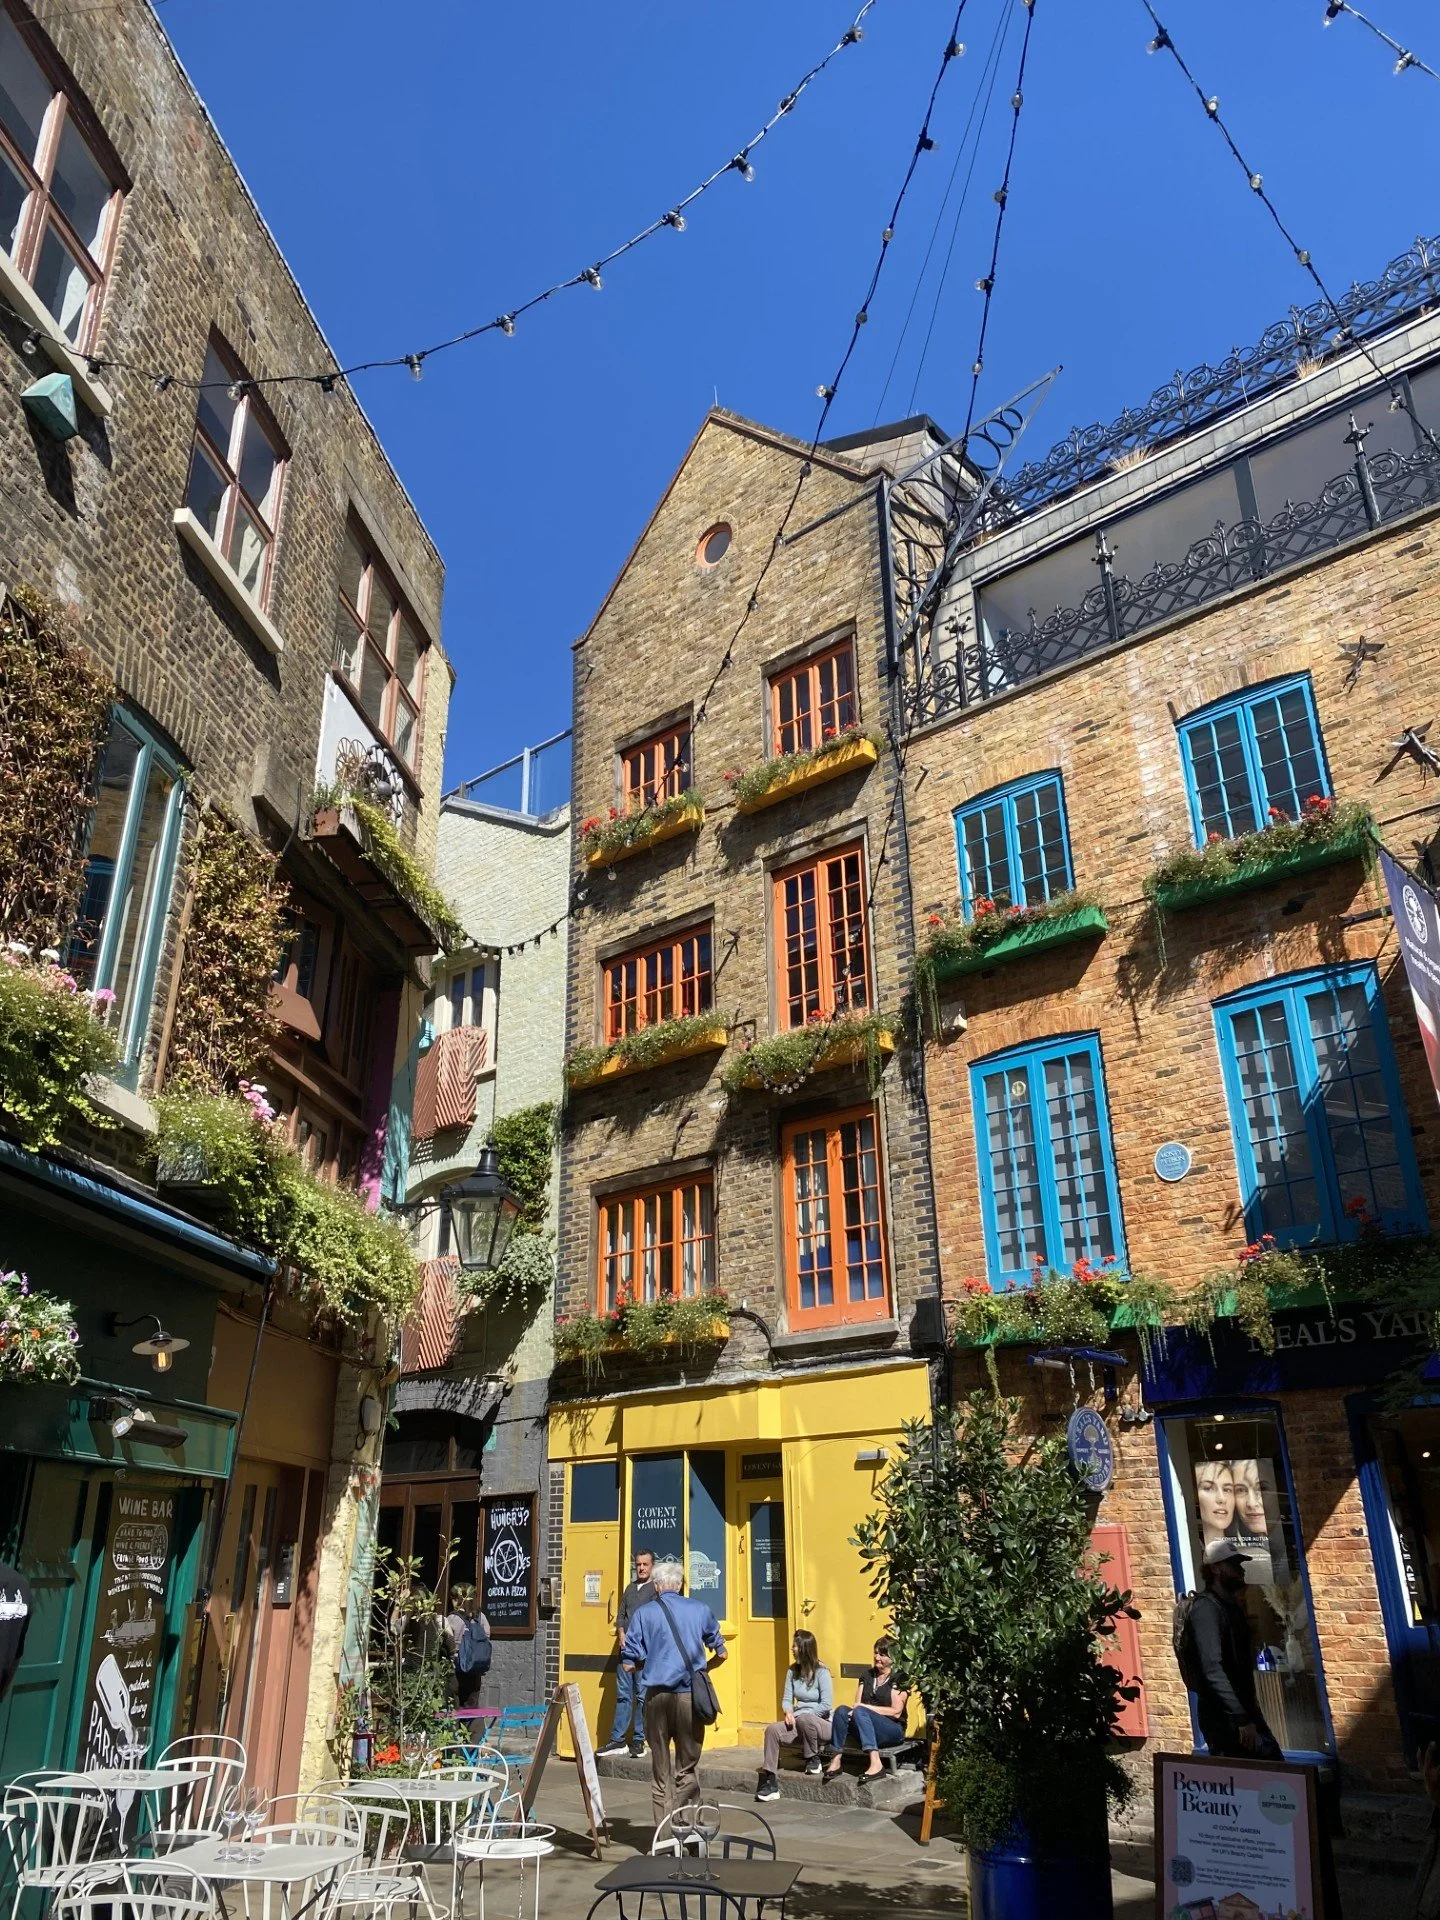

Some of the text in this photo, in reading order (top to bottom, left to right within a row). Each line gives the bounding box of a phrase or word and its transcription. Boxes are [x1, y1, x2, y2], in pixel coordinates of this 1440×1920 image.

[1361, 1309, 1432, 1339] YAR
[119, 1496, 174, 1519] WINE BAR
[637, 1506, 677, 1518] COVENT
[490, 1509, 530, 1530] HUNGRY?
[637, 1518, 677, 1529] GARDEN
[484, 1556, 494, 1573] NO
[487, 1586, 527, 1597] ORDER A PIZZA
[88, 1700, 120, 1769] PARIS
[1173, 1771, 1235, 1799] Beyond
[1182, 1792, 1242, 1824] Beauty
[1262, 1801, 1296, 1810] SEPTEMBER
